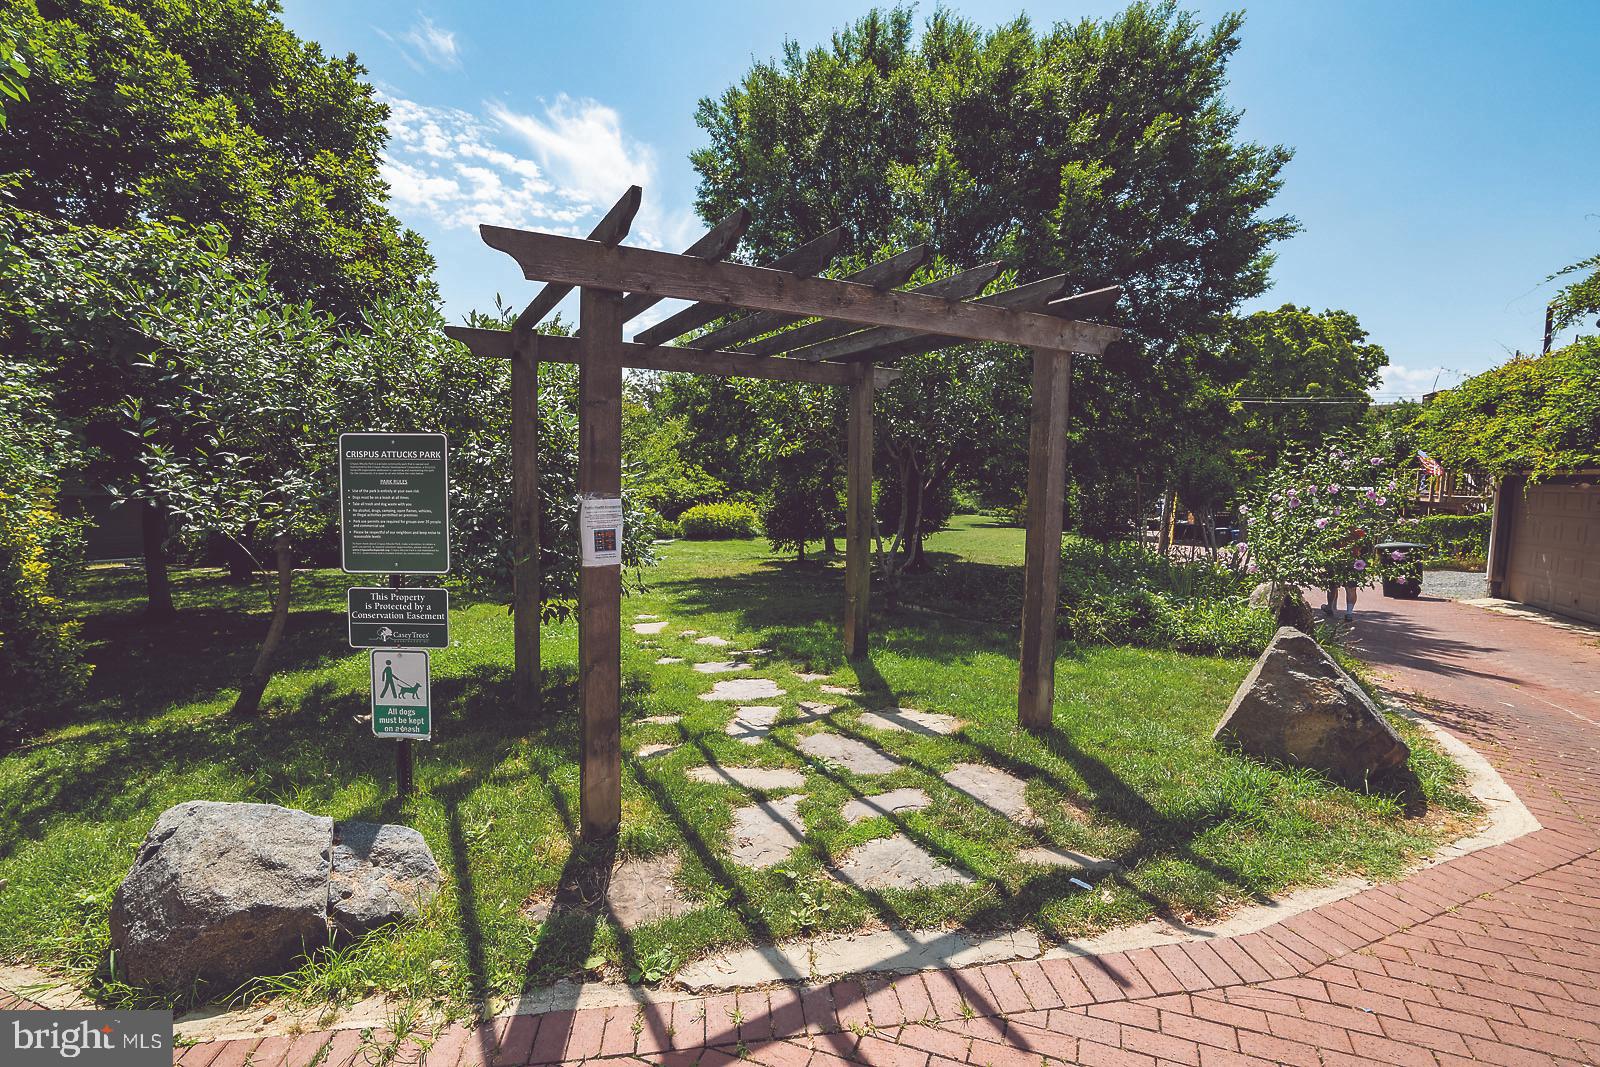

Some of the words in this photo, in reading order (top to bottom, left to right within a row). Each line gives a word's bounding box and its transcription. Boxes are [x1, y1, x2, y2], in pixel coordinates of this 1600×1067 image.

[391, 594, 425, 602] Property
[414, 603, 424, 612] by
[352, 611, 404, 619] Conservation
[406, 611, 444, 619] Easement
[409, 718, 424, 726] kept
